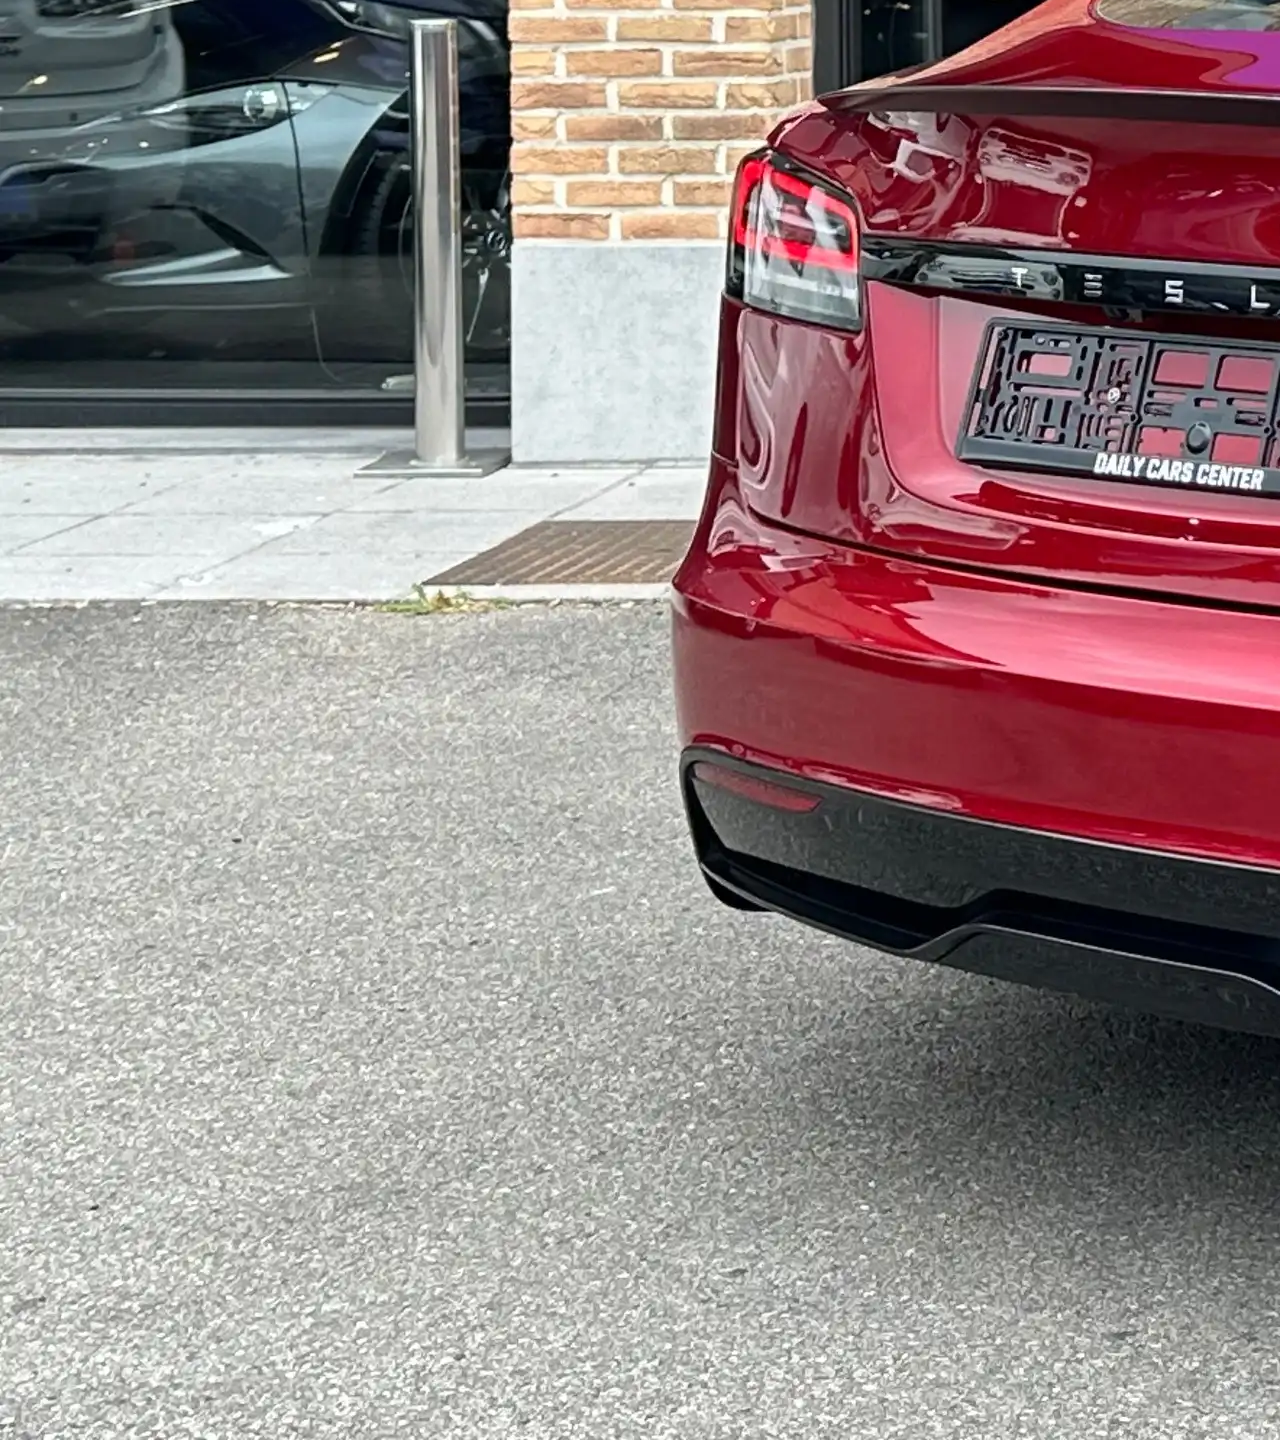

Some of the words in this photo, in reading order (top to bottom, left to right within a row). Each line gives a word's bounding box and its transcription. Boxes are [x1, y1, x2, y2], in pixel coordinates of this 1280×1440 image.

[1093, 452, 1144, 477] DAILY
[1146, 458, 1194, 483] CARS
[1195, 463, 1266, 491] CENTER
